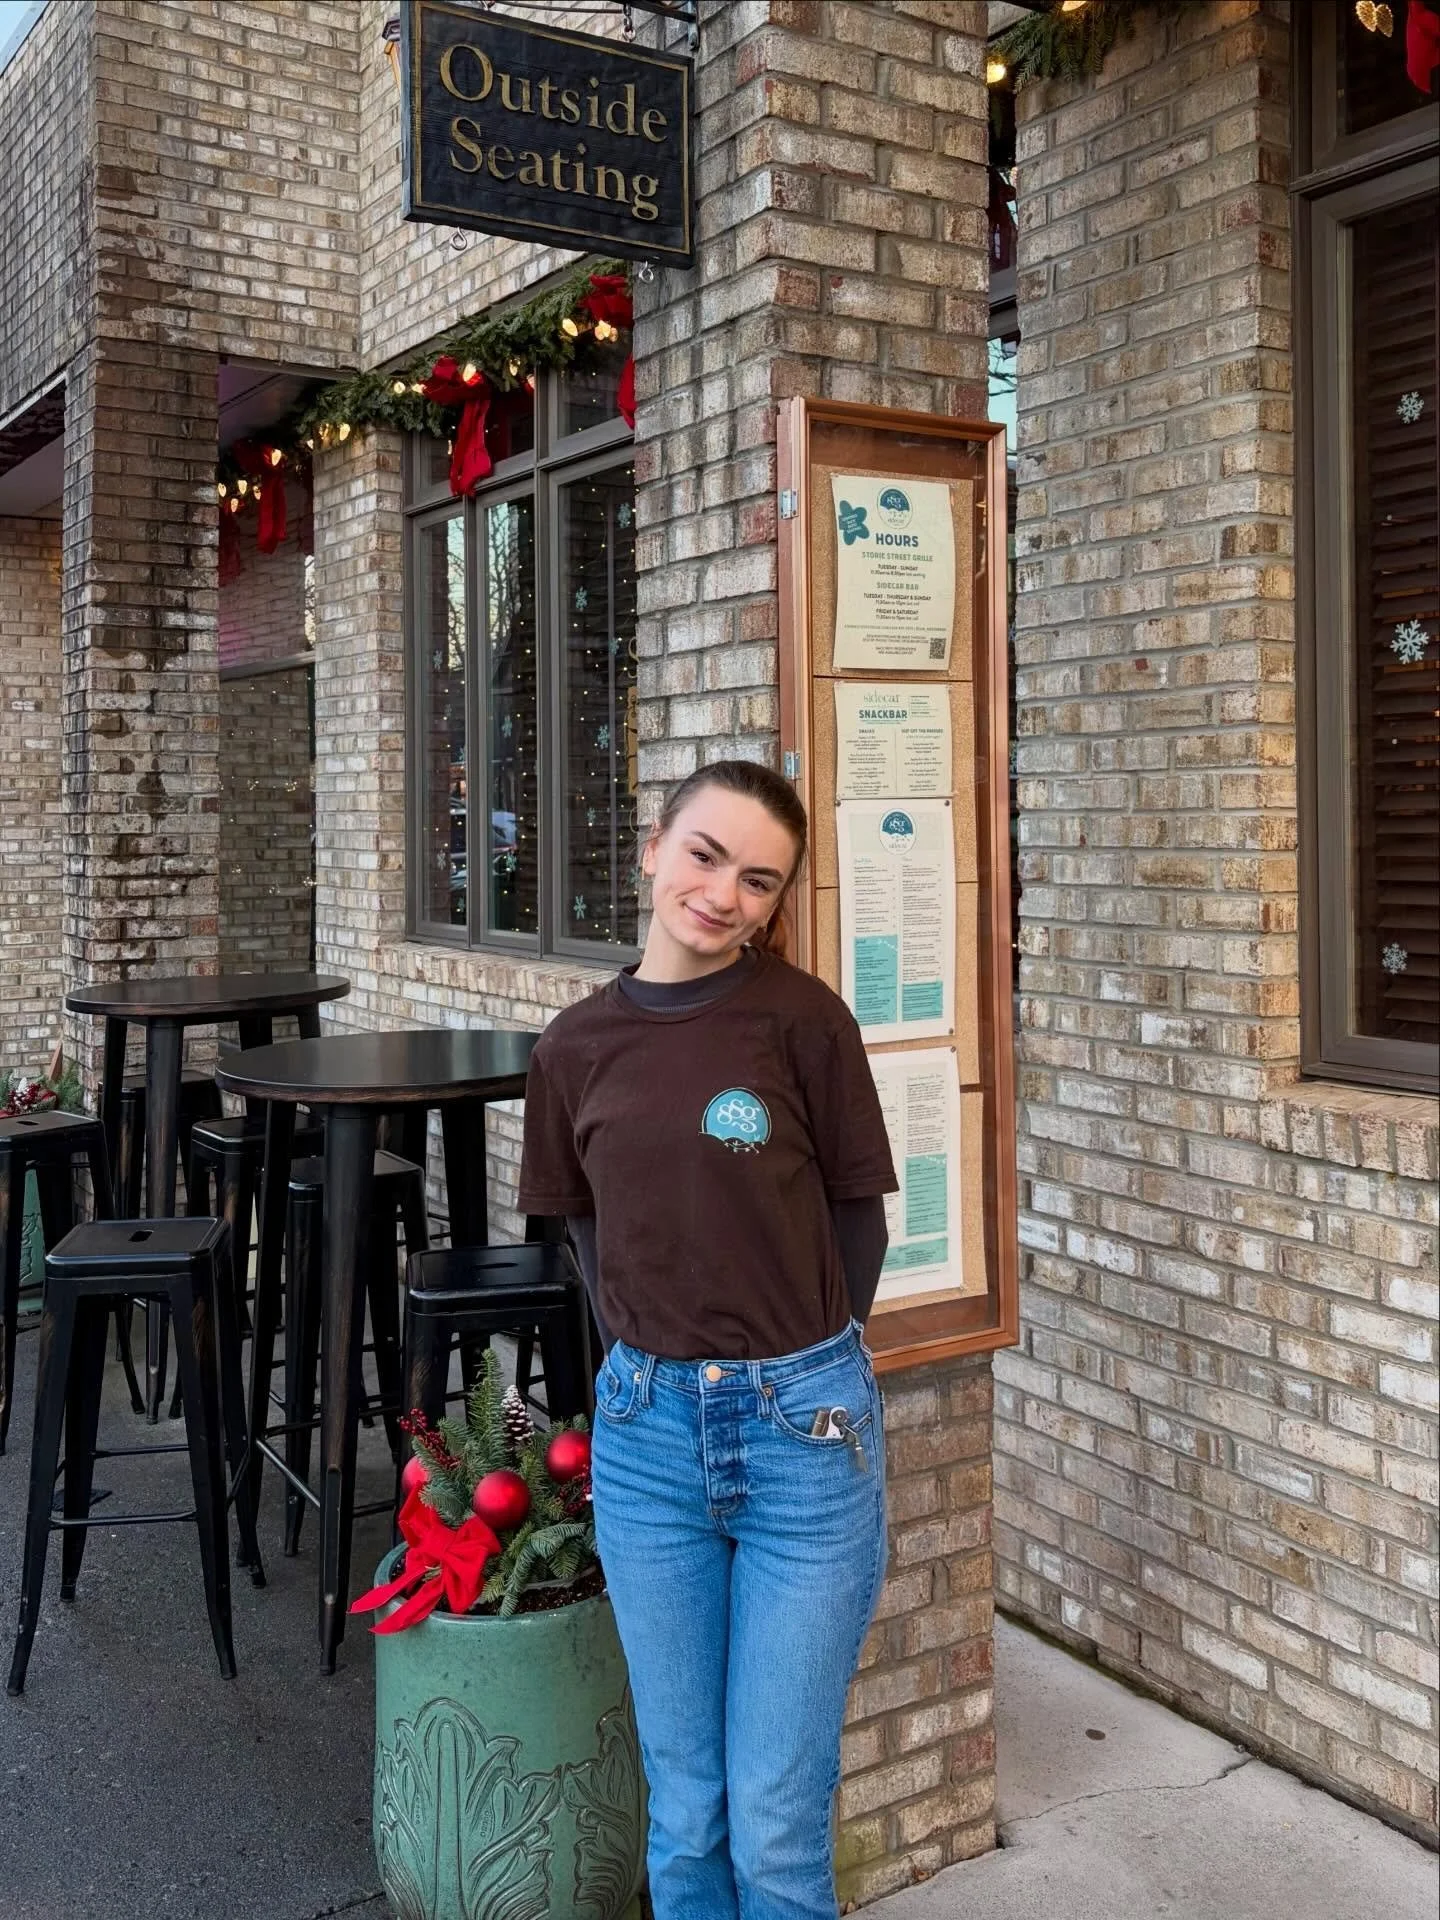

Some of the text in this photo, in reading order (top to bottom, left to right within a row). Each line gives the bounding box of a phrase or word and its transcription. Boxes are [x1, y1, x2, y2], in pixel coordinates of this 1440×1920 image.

[439, 43, 668, 143] Outside
[450, 116, 660, 221] Seating
[875, 533, 919, 548] HOURS
[886, 552, 911, 561] STREET
[912, 554, 933, 562] GRILLE
[876, 582, 904, 590] SIDECAR
[858, 709, 908, 719] SNACKBAR
